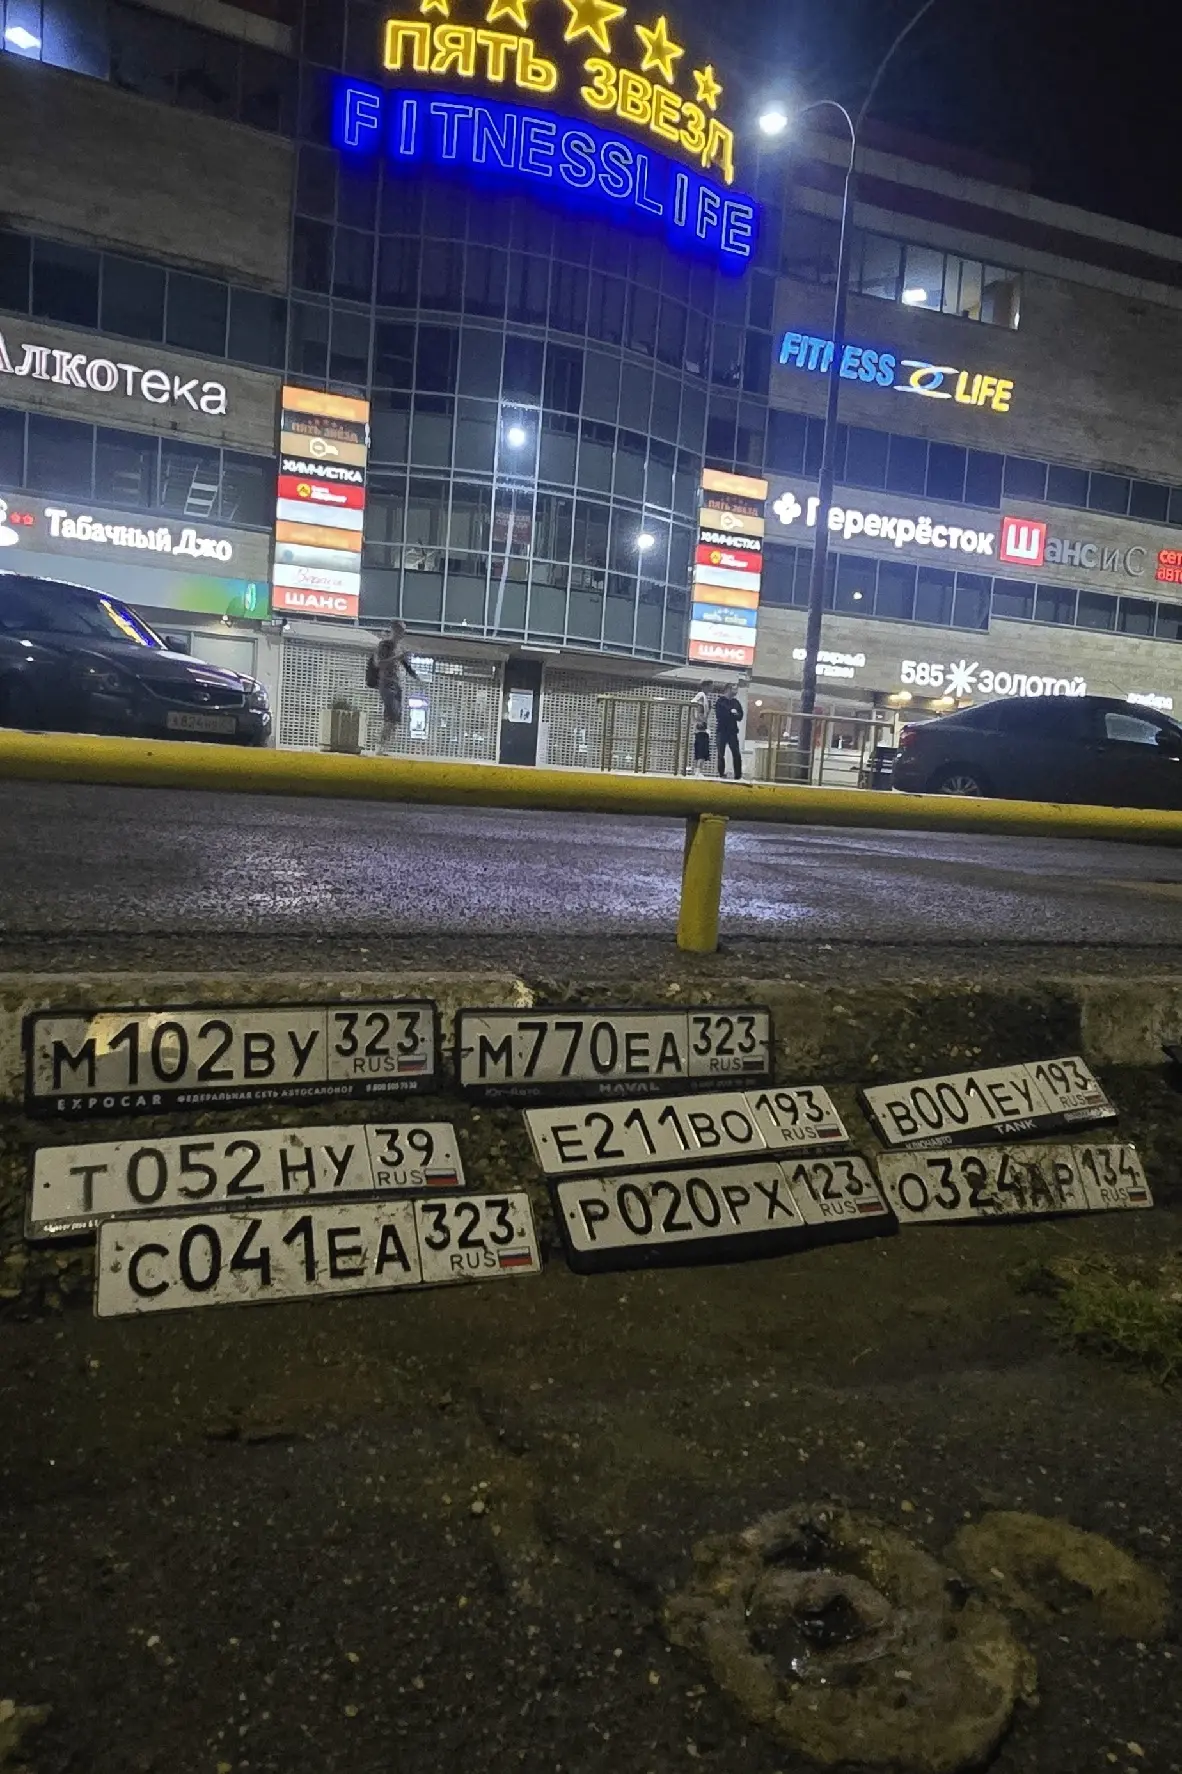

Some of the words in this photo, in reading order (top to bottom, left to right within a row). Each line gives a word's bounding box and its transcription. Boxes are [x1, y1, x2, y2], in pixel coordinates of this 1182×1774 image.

[384, 19, 558, 92] ПЯТЬ
[580, 58, 735, 185] ЗВЕЗД
[955, 371, 1014, 412] LIFE
[44, 507, 172, 552] Табачный
[172, 529, 233, 561] Джо
[284, 591, 348, 611] ШАНС
[698, 644, 745, 661] ШАНС
[900, 659, 944, 687] 585
[52, 1019, 320, 1089] М102ВУ
[334, 1012, 421, 1057] 323
[478, 1021, 682, 1078] М770ЕА
[692, 1016, 756, 1055] 323
[353, 1055, 395, 1074] RUS
[709, 1058, 742, 1072] RUS
[599, 1082, 660, 1094] HAVAL
[885, 1076, 1034, 1137] В001ЕУ
[1035, 1060, 1090, 1096] 193
[57, 1094, 162, 1111] EXPOCAR
[1059, 1094, 1086, 1107] RUS
[550, 1105, 754, 1164] Е211ВО
[755, 1090, 824, 1127] 193
[780, 1127, 817, 1143] RUS
[995, 1118, 1037, 1135] TANK
[69, 1140, 355, 1211] Т052НУ
[374, 1128, 435, 1168] 39
[378, 1169, 424, 1186] RUS
[1081, 1147, 1136, 1188] 134
[578, 1176, 794, 1242] Р020РХ
[792, 1160, 864, 1201] 123
[1100, 1188, 1128, 1202] RUS
[819, 1201, 857, 1217] RUS
[127, 1215, 412, 1298] С041ЕА
[424, 1199, 516, 1250] 323
[450, 1248, 497, 1270] RUS
